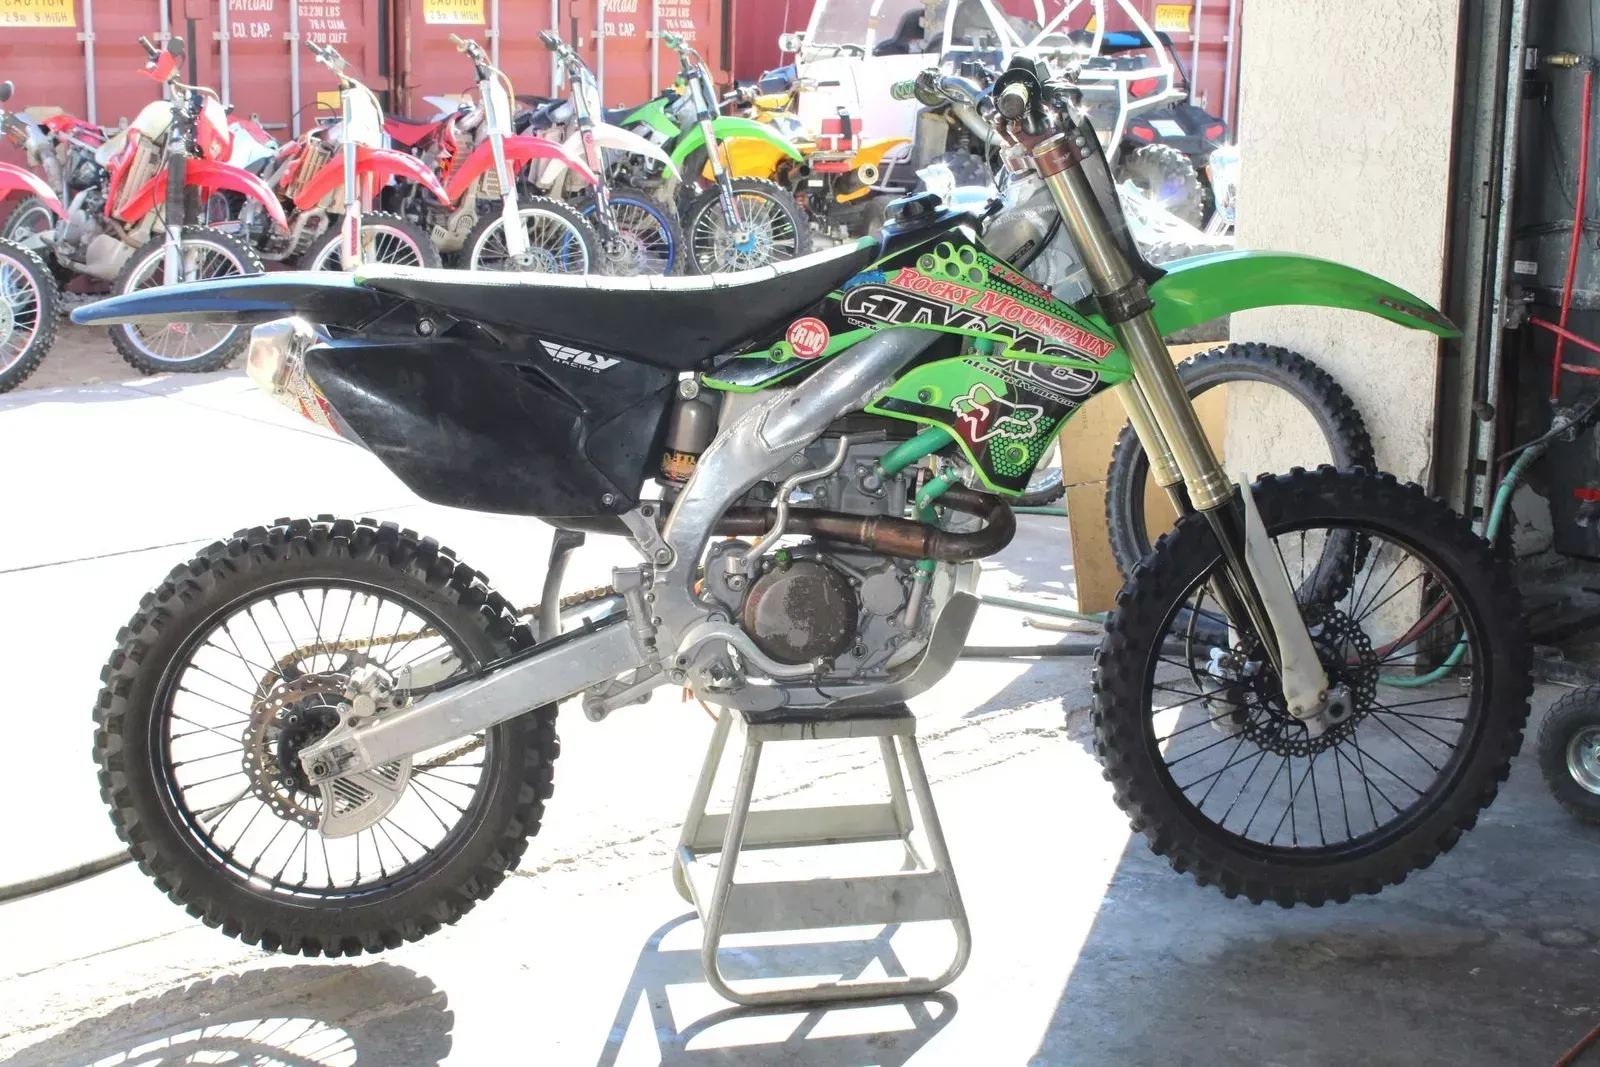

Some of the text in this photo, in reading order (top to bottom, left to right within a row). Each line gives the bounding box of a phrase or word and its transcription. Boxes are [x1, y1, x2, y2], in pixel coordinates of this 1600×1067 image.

[325, 6, 341, 17] LBS
[250, 22, 273, 38] CAP.
[618, 22, 637, 37] CAP.
[990, 263, 1054, 303] TUSK
[888, 266, 1116, 359] ROCKY MOUNTAIN
[538, 339, 622, 370] FLY
[552, 357, 601, 374] RACING
